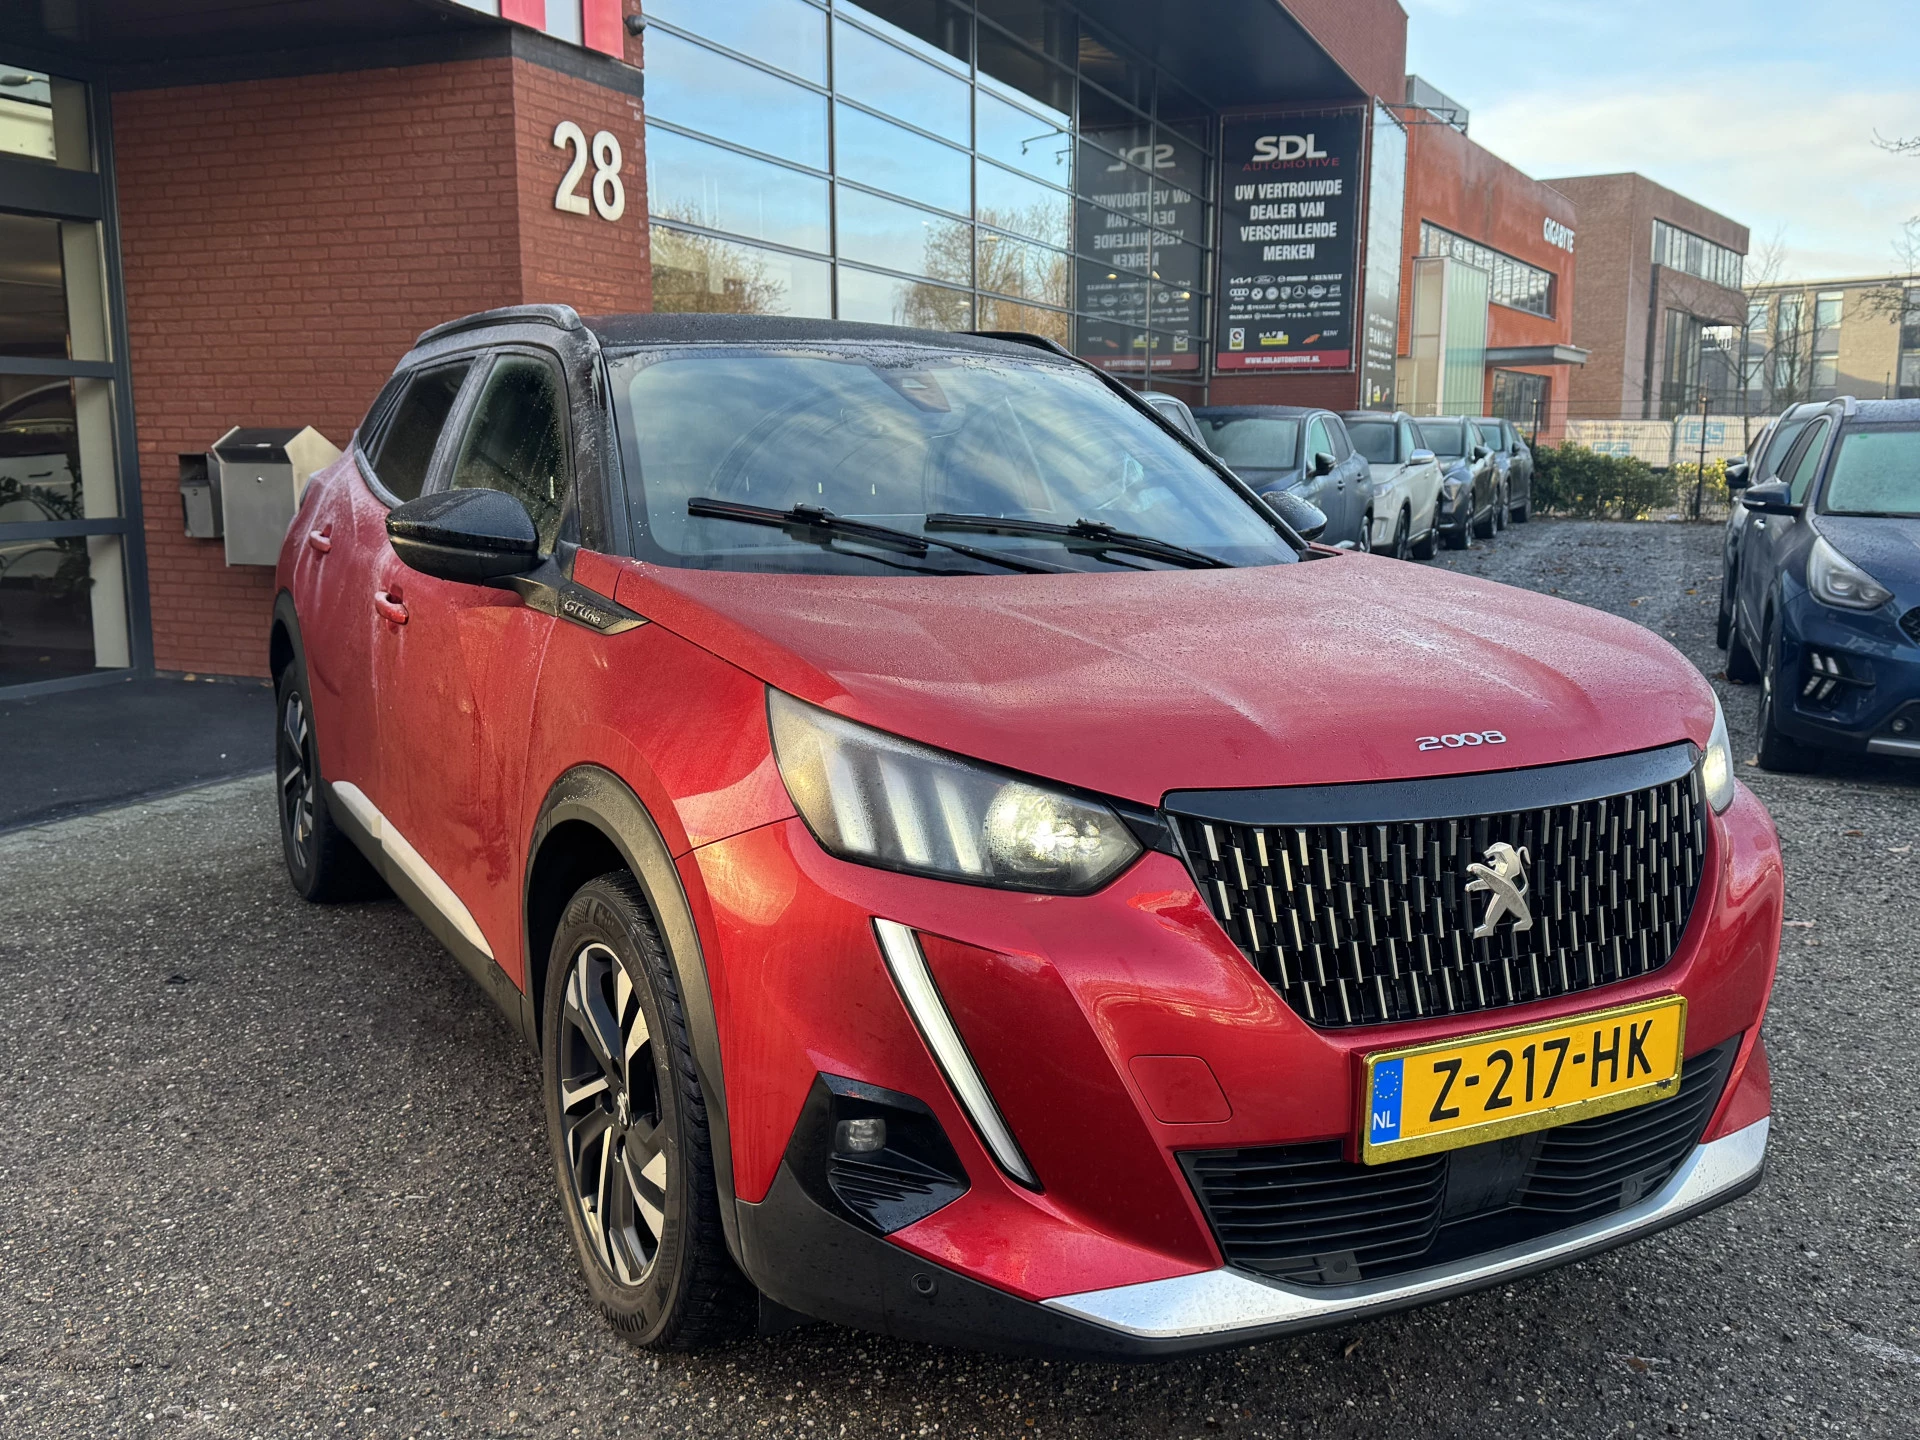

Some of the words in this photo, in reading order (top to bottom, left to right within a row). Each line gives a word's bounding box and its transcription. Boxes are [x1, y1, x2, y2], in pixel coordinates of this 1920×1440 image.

[1252, 134, 1327, 161] SDL
[553, 120, 625, 222] 28
[1242, 157, 1340, 171] AUTOMOTIVE
[1235, 184, 1255, 200] UW
[1258, 179, 1342, 199] VERTROUWDE
[1250, 203, 1296, 220] DEALER
[1300, 201, 1325, 217] VAN
[1240, 222, 1337, 242] VERSCHILLENDE
[1263, 244, 1315, 261] MERKEN
[1415, 730, 1506, 751] 2008
[1429, 1019, 1653, 1122] Z-217-HK
[1373, 1111, 1395, 1131] NL
